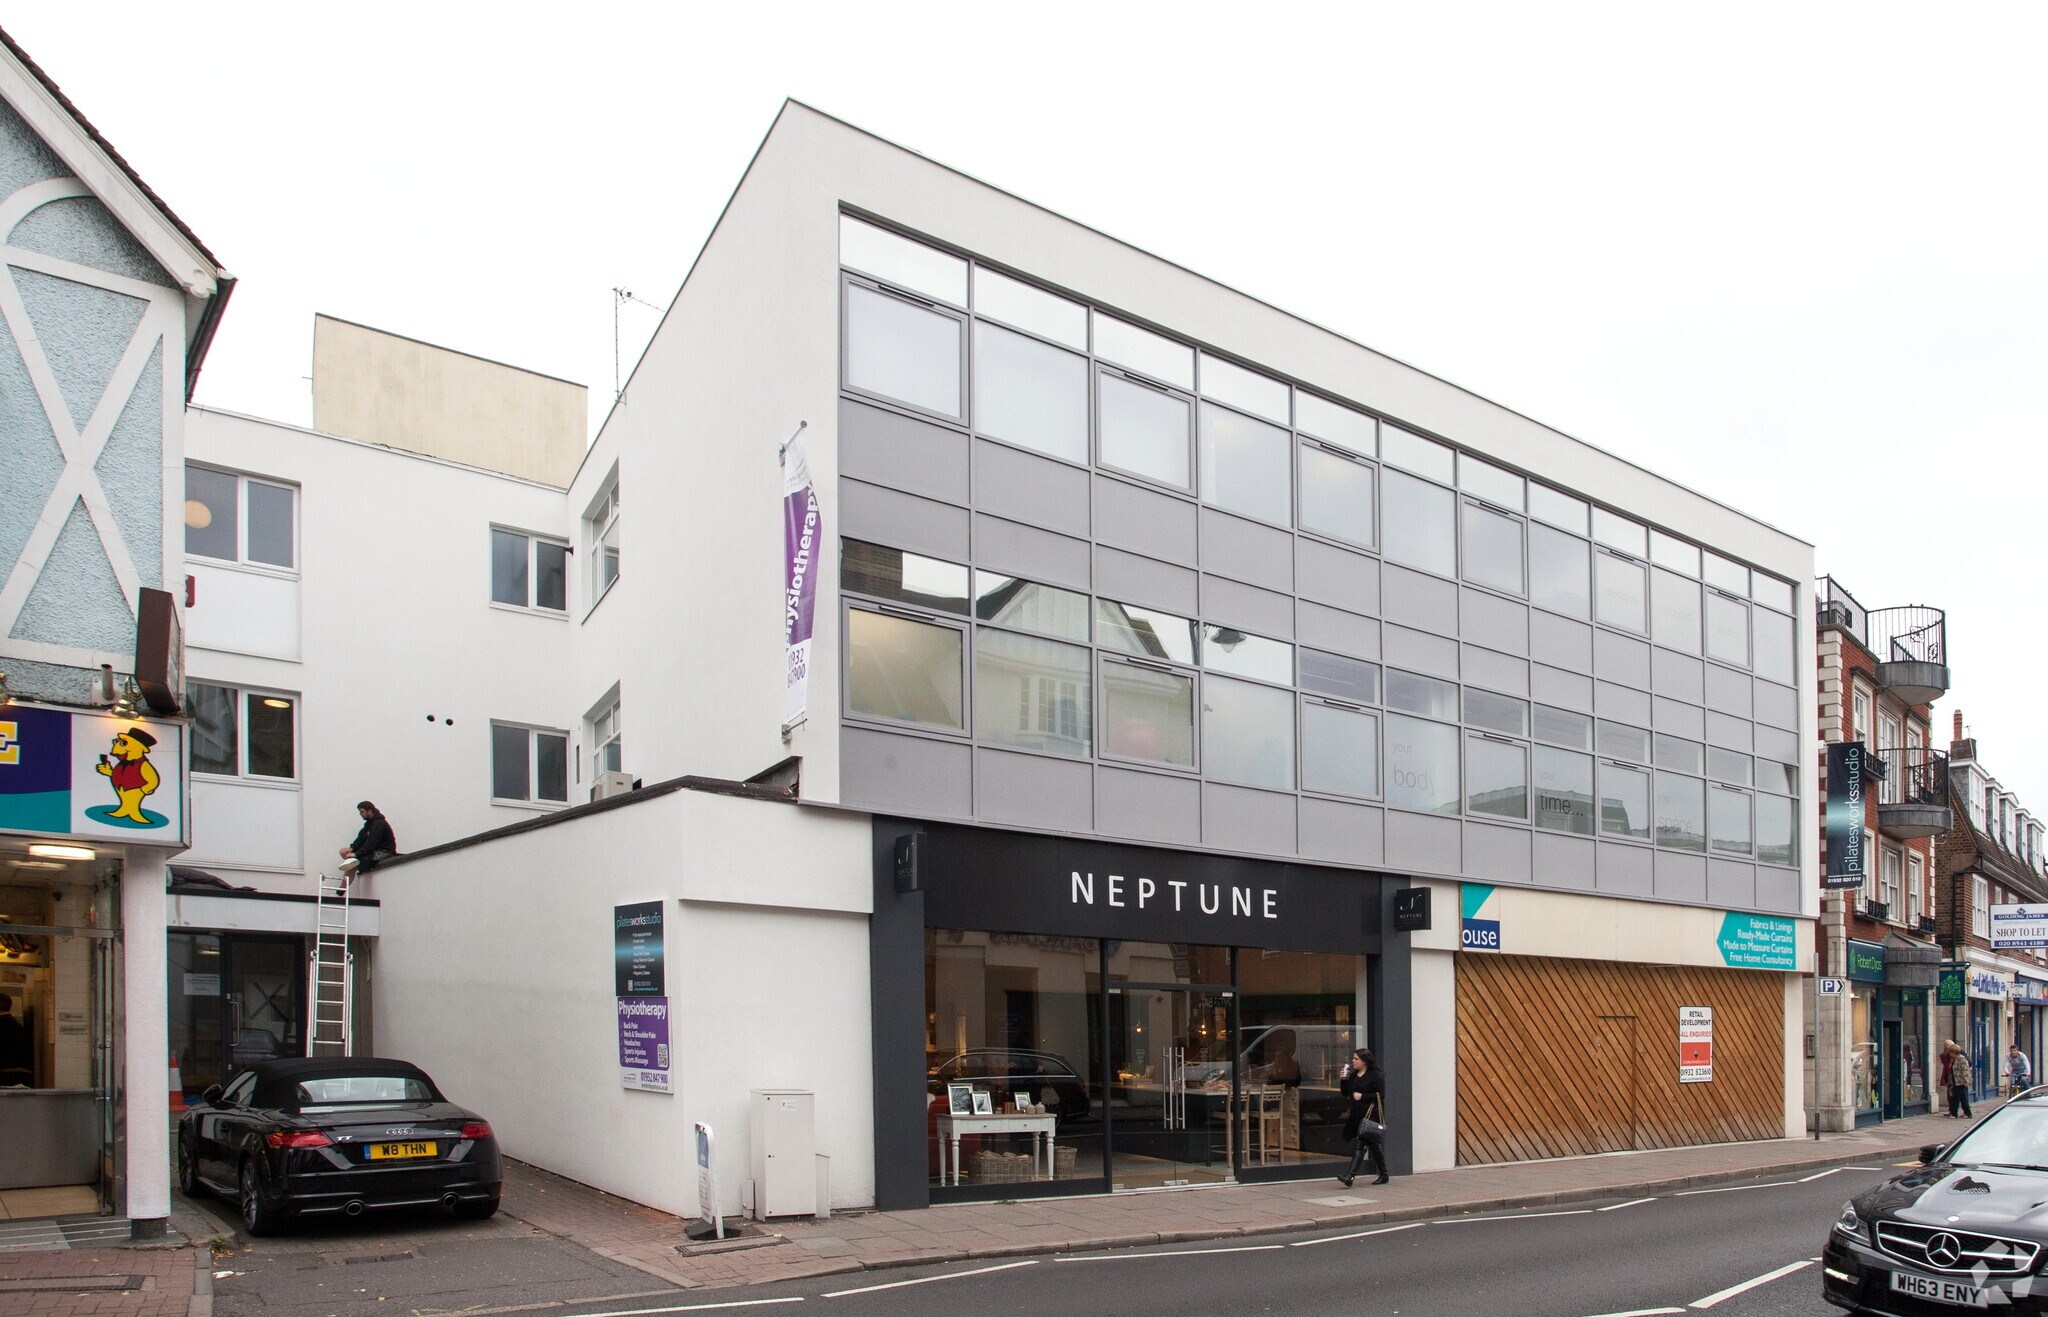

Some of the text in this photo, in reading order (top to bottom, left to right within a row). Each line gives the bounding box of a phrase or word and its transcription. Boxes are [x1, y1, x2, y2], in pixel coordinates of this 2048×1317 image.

[1844, 748, 1861, 872] pilatesworksstudio
[1072, 872, 1278, 919] NEPTUNE
[1750, 919, 1793, 934] Fabrics & Linings
[1996, 927, 2047, 937] SHOP TO LET
[1462, 929, 1497, 946] ouse
[1737, 929, 1793, 943] Ready-Made Curtains
[1723, 940, 1739, 950] Made
[1747, 942, 1770, 952] Measure
[1771, 944, 1793, 954] Curtains
[1729, 952, 1793, 967] Free Home Consultancy
[1825, 981, 1833, 991] P
[618, 1000, 667, 1019] Physiotherapy
[634, 1031, 649, 1039] Shoulder
[624, 1047, 646, 1056] Sports Injuries
[624, 1056, 635, 1064] Sports
[640, 1072, 652, 1082] 01932
[382, 1143, 427, 1156] W8 THN
[1898, 1274, 1982, 1304] WH63 ENY
